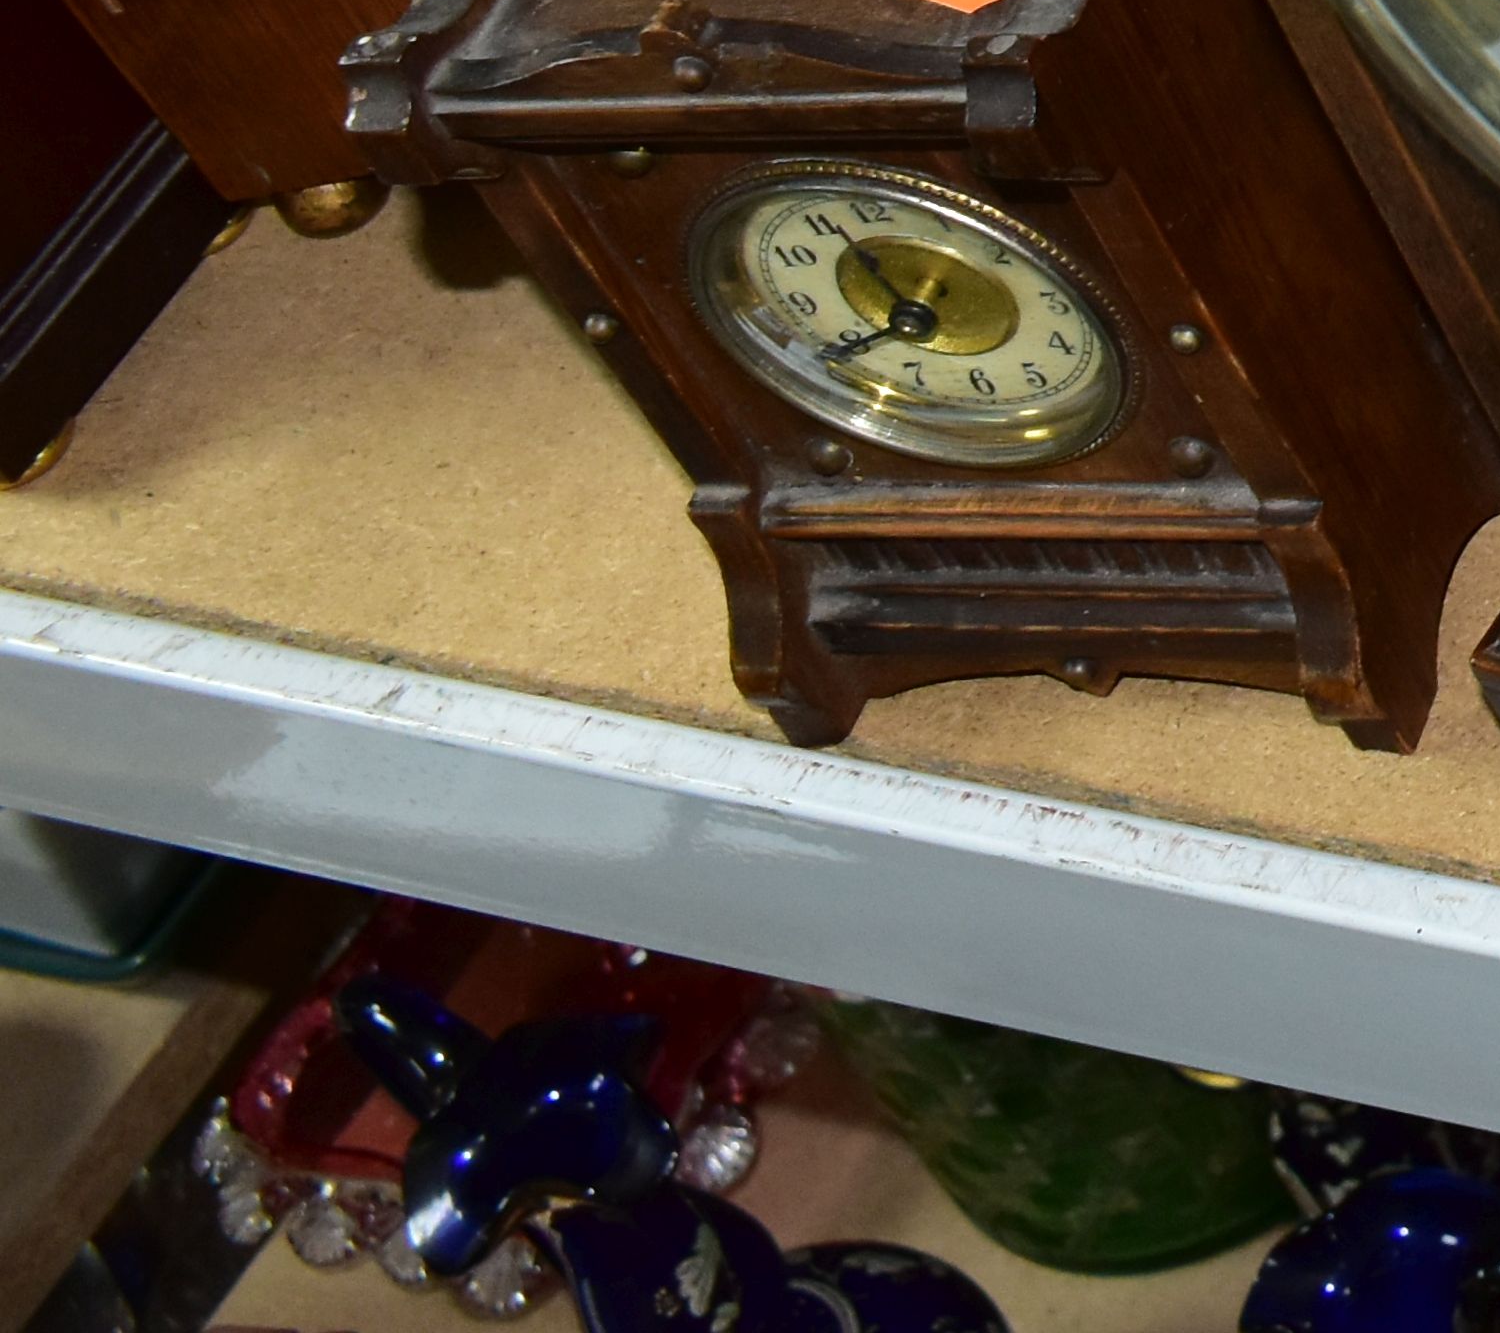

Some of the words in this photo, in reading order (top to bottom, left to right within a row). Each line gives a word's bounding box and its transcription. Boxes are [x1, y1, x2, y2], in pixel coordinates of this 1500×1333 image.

[850, 201, 894, 223] 12
[804, 214, 839, 236] 11
[775, 245, 817, 267] 10
[789, 292, 816, 315] 9
[1039, 291, 1069, 315] 3
[1048, 331, 1076, 355] 4
[903, 361, 925, 385] 7
[970, 368, 995, 395] 6
[1022, 362, 1047, 388] 5
